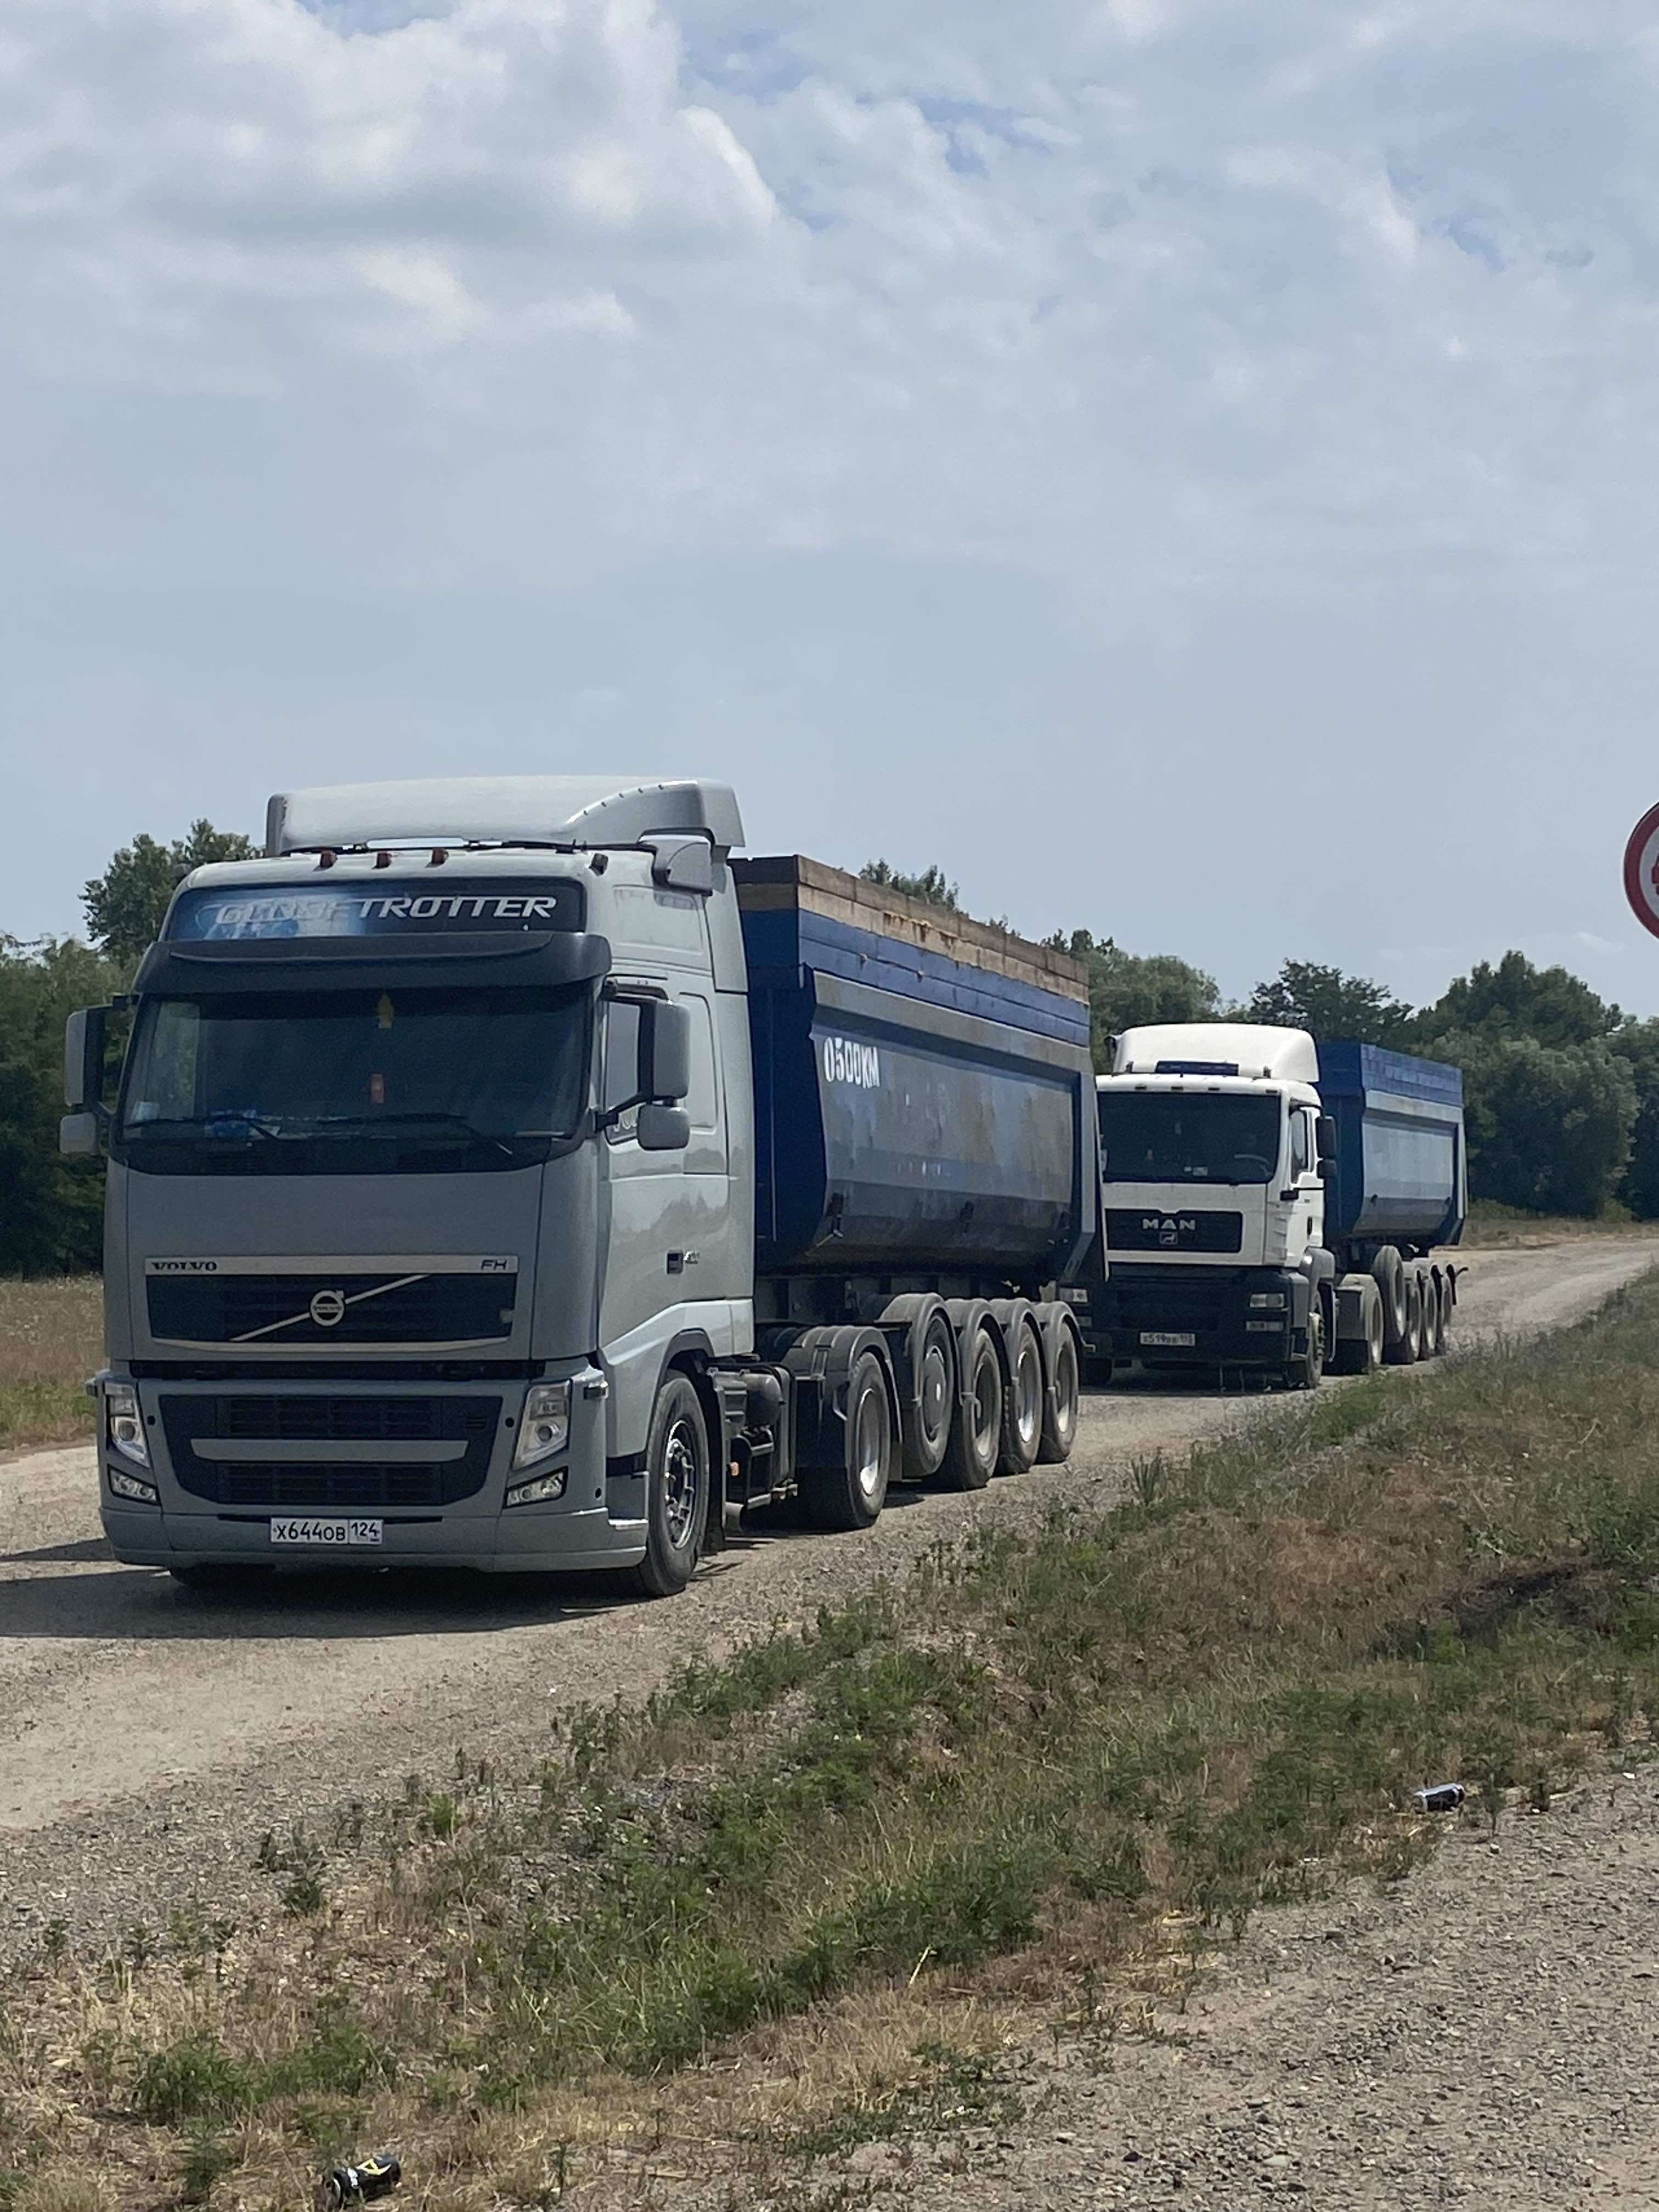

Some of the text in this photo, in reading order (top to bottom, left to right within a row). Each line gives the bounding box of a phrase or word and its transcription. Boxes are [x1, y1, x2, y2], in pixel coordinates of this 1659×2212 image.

[1142, 1218, 1196, 1230] MAN
[151, 1261, 217, 1271] VOLVO
[481, 1259, 507, 1271] FH
[276, 1521, 377, 1541] Х644ОВ 124
